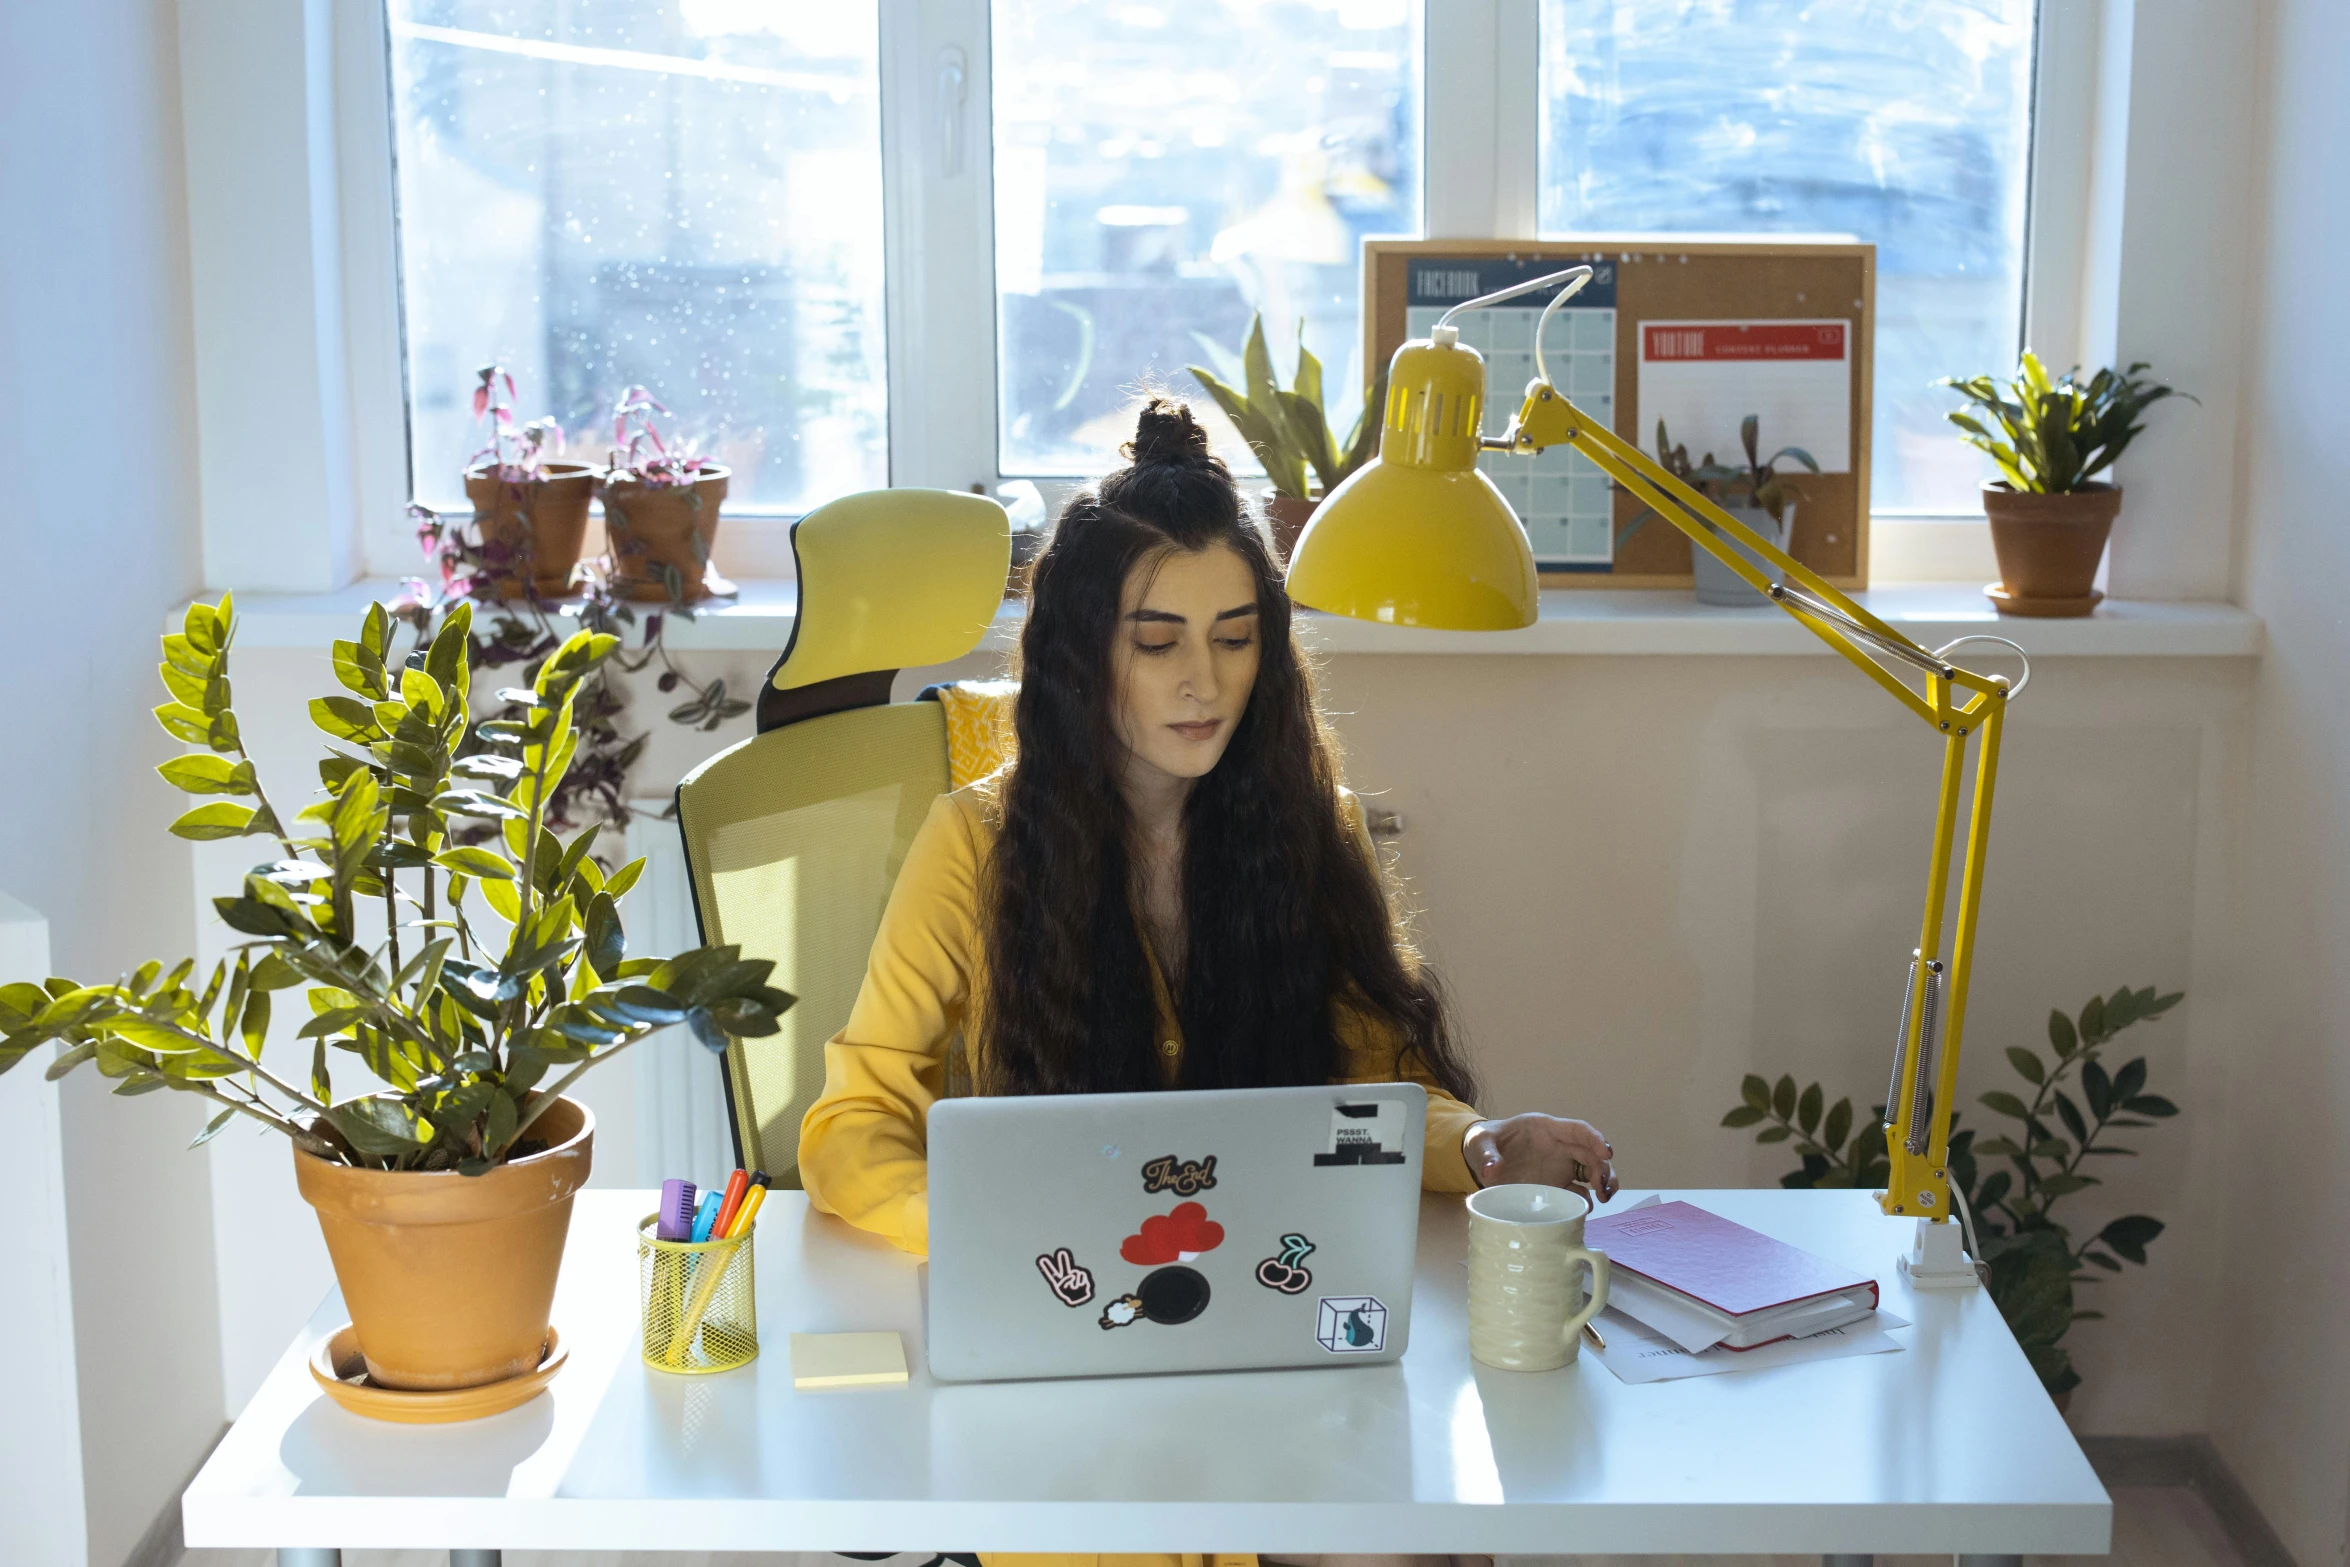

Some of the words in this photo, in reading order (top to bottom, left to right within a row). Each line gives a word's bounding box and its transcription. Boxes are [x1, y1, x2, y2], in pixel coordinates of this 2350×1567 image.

[1417, 270, 1480, 297] FACEBOOK
[1652, 331, 1704, 357] YOUTUBE
[1336, 1128, 1370, 1136] PSSST.
[1336, 1136, 1373, 1144] WANNA
[1146, 1159, 1178, 1190] The
[1175, 1159, 1212, 1193] End
